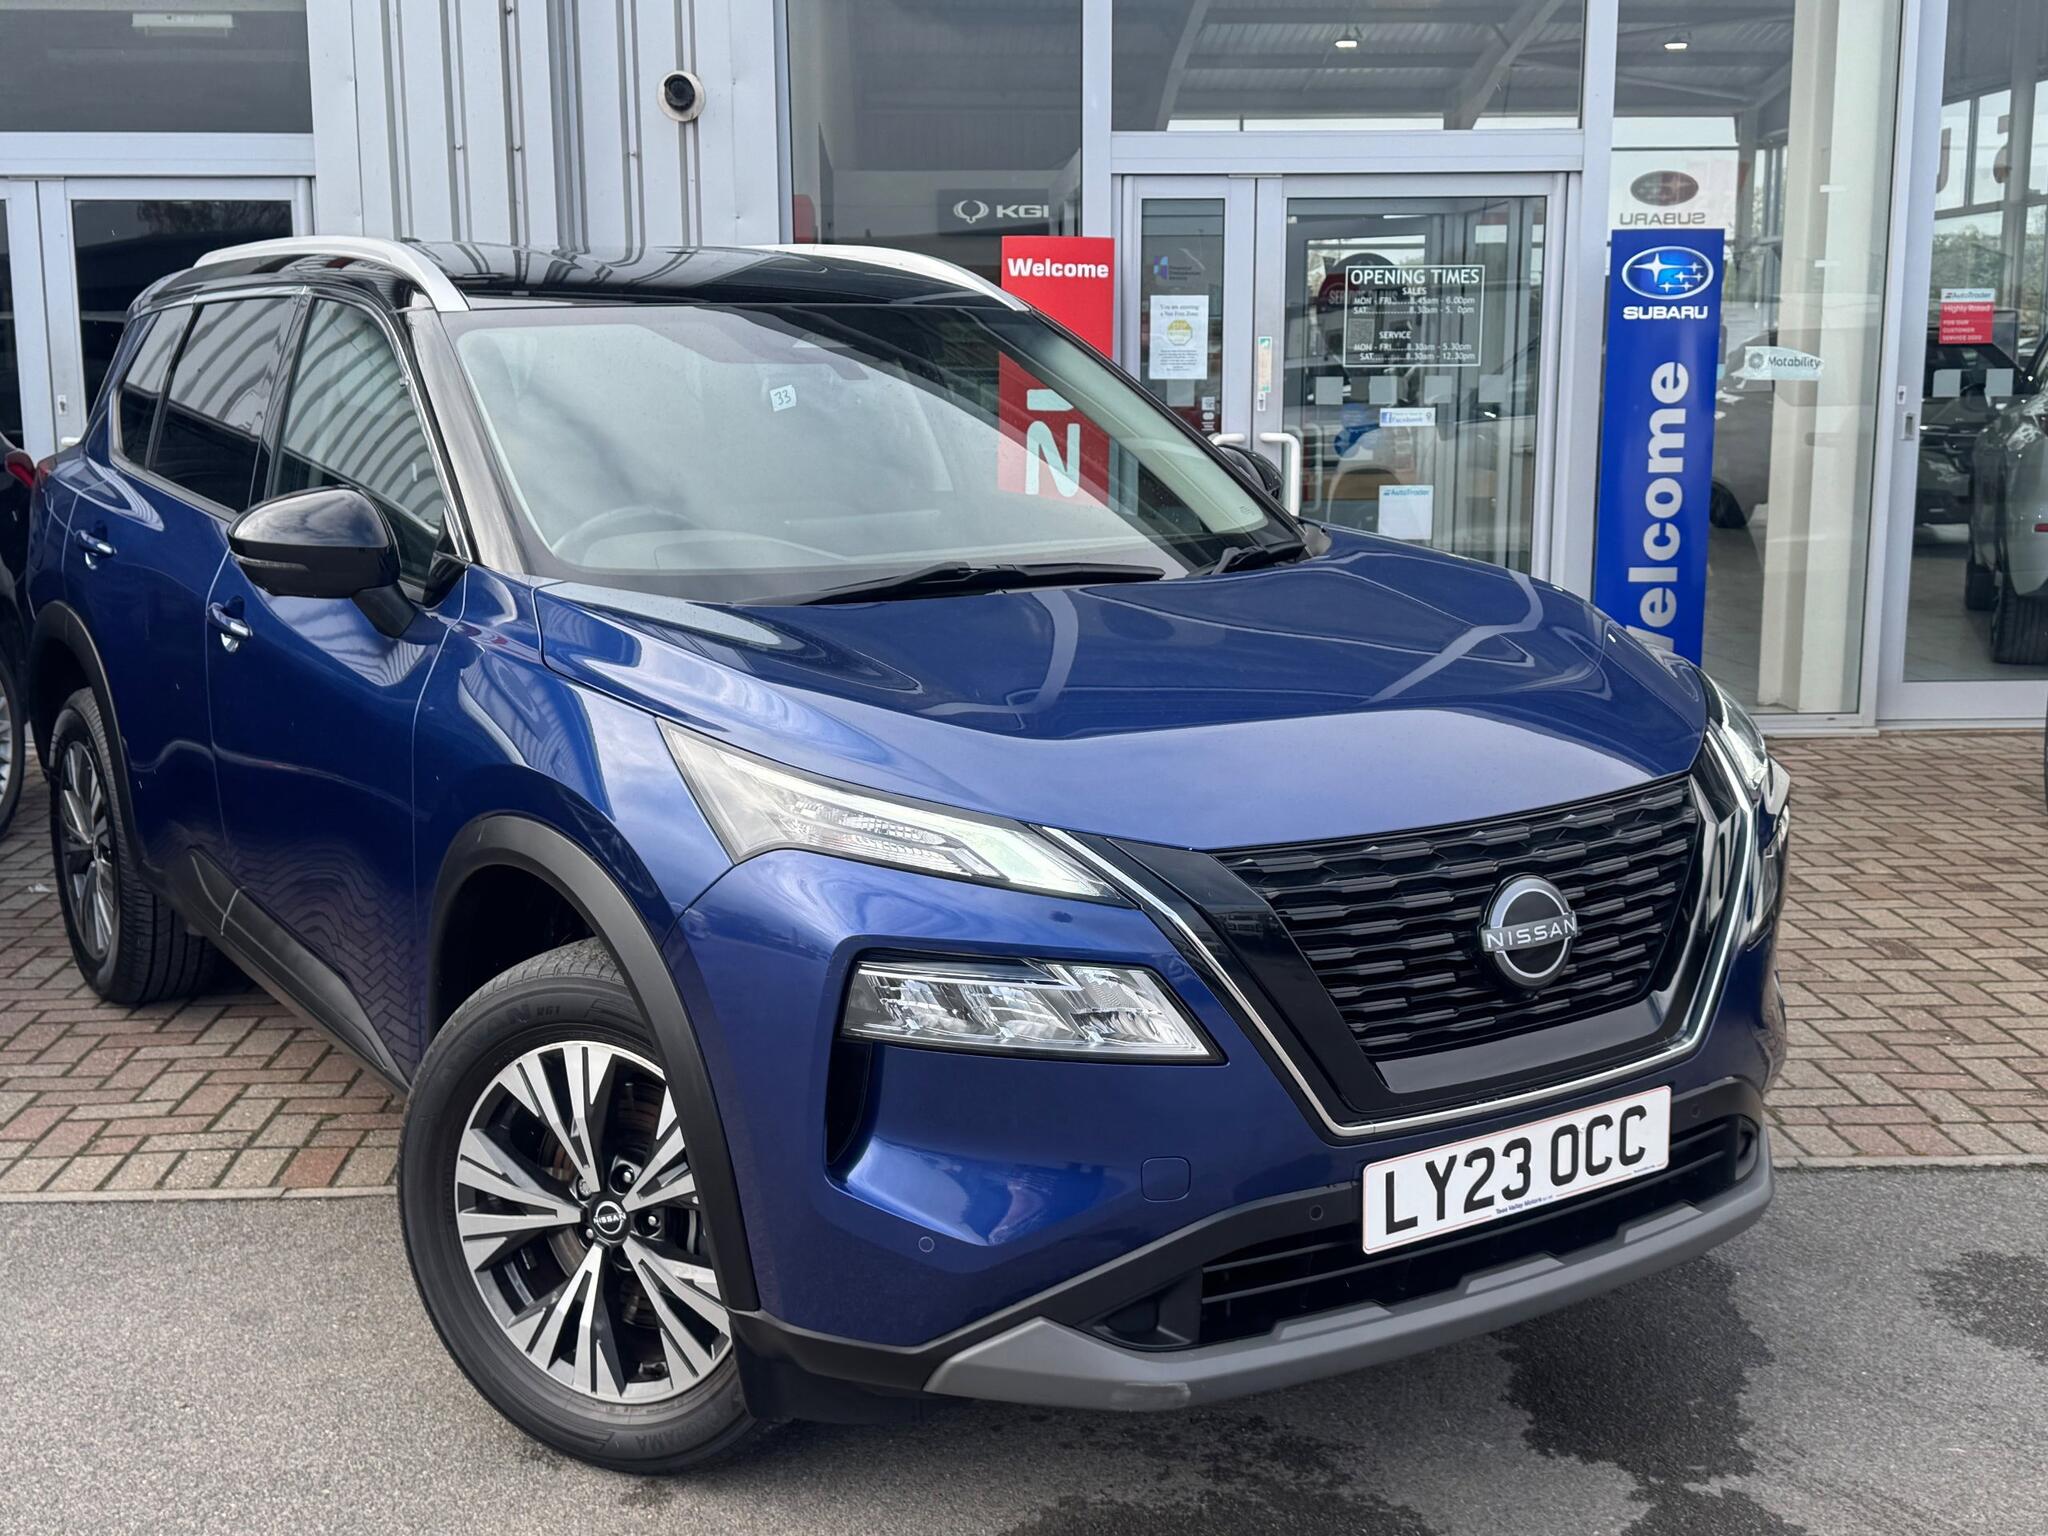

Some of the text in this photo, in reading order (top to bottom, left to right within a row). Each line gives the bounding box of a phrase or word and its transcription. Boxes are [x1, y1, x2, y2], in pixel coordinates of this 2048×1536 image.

[1007, 257, 1109, 278] Welcome
[1350, 269, 1480, 285] OPENING TIMES
[1401, 286, 1427, 296] SALES
[1622, 304, 1709, 320] SUBARU
[1378, 331, 1412, 340] SERVICE
[1354, 343, 1373, 352] MON
[1768, 356, 1820, 369] Motability
[774, 390, 791, 406] 33
[1626, 361, 1690, 651] elcome
[1485, 917, 1577, 949] NISSAN
[1385, 1104, 1648, 1236] LY23 OCC
[593, 1212, 627, 1224] NISSAN
